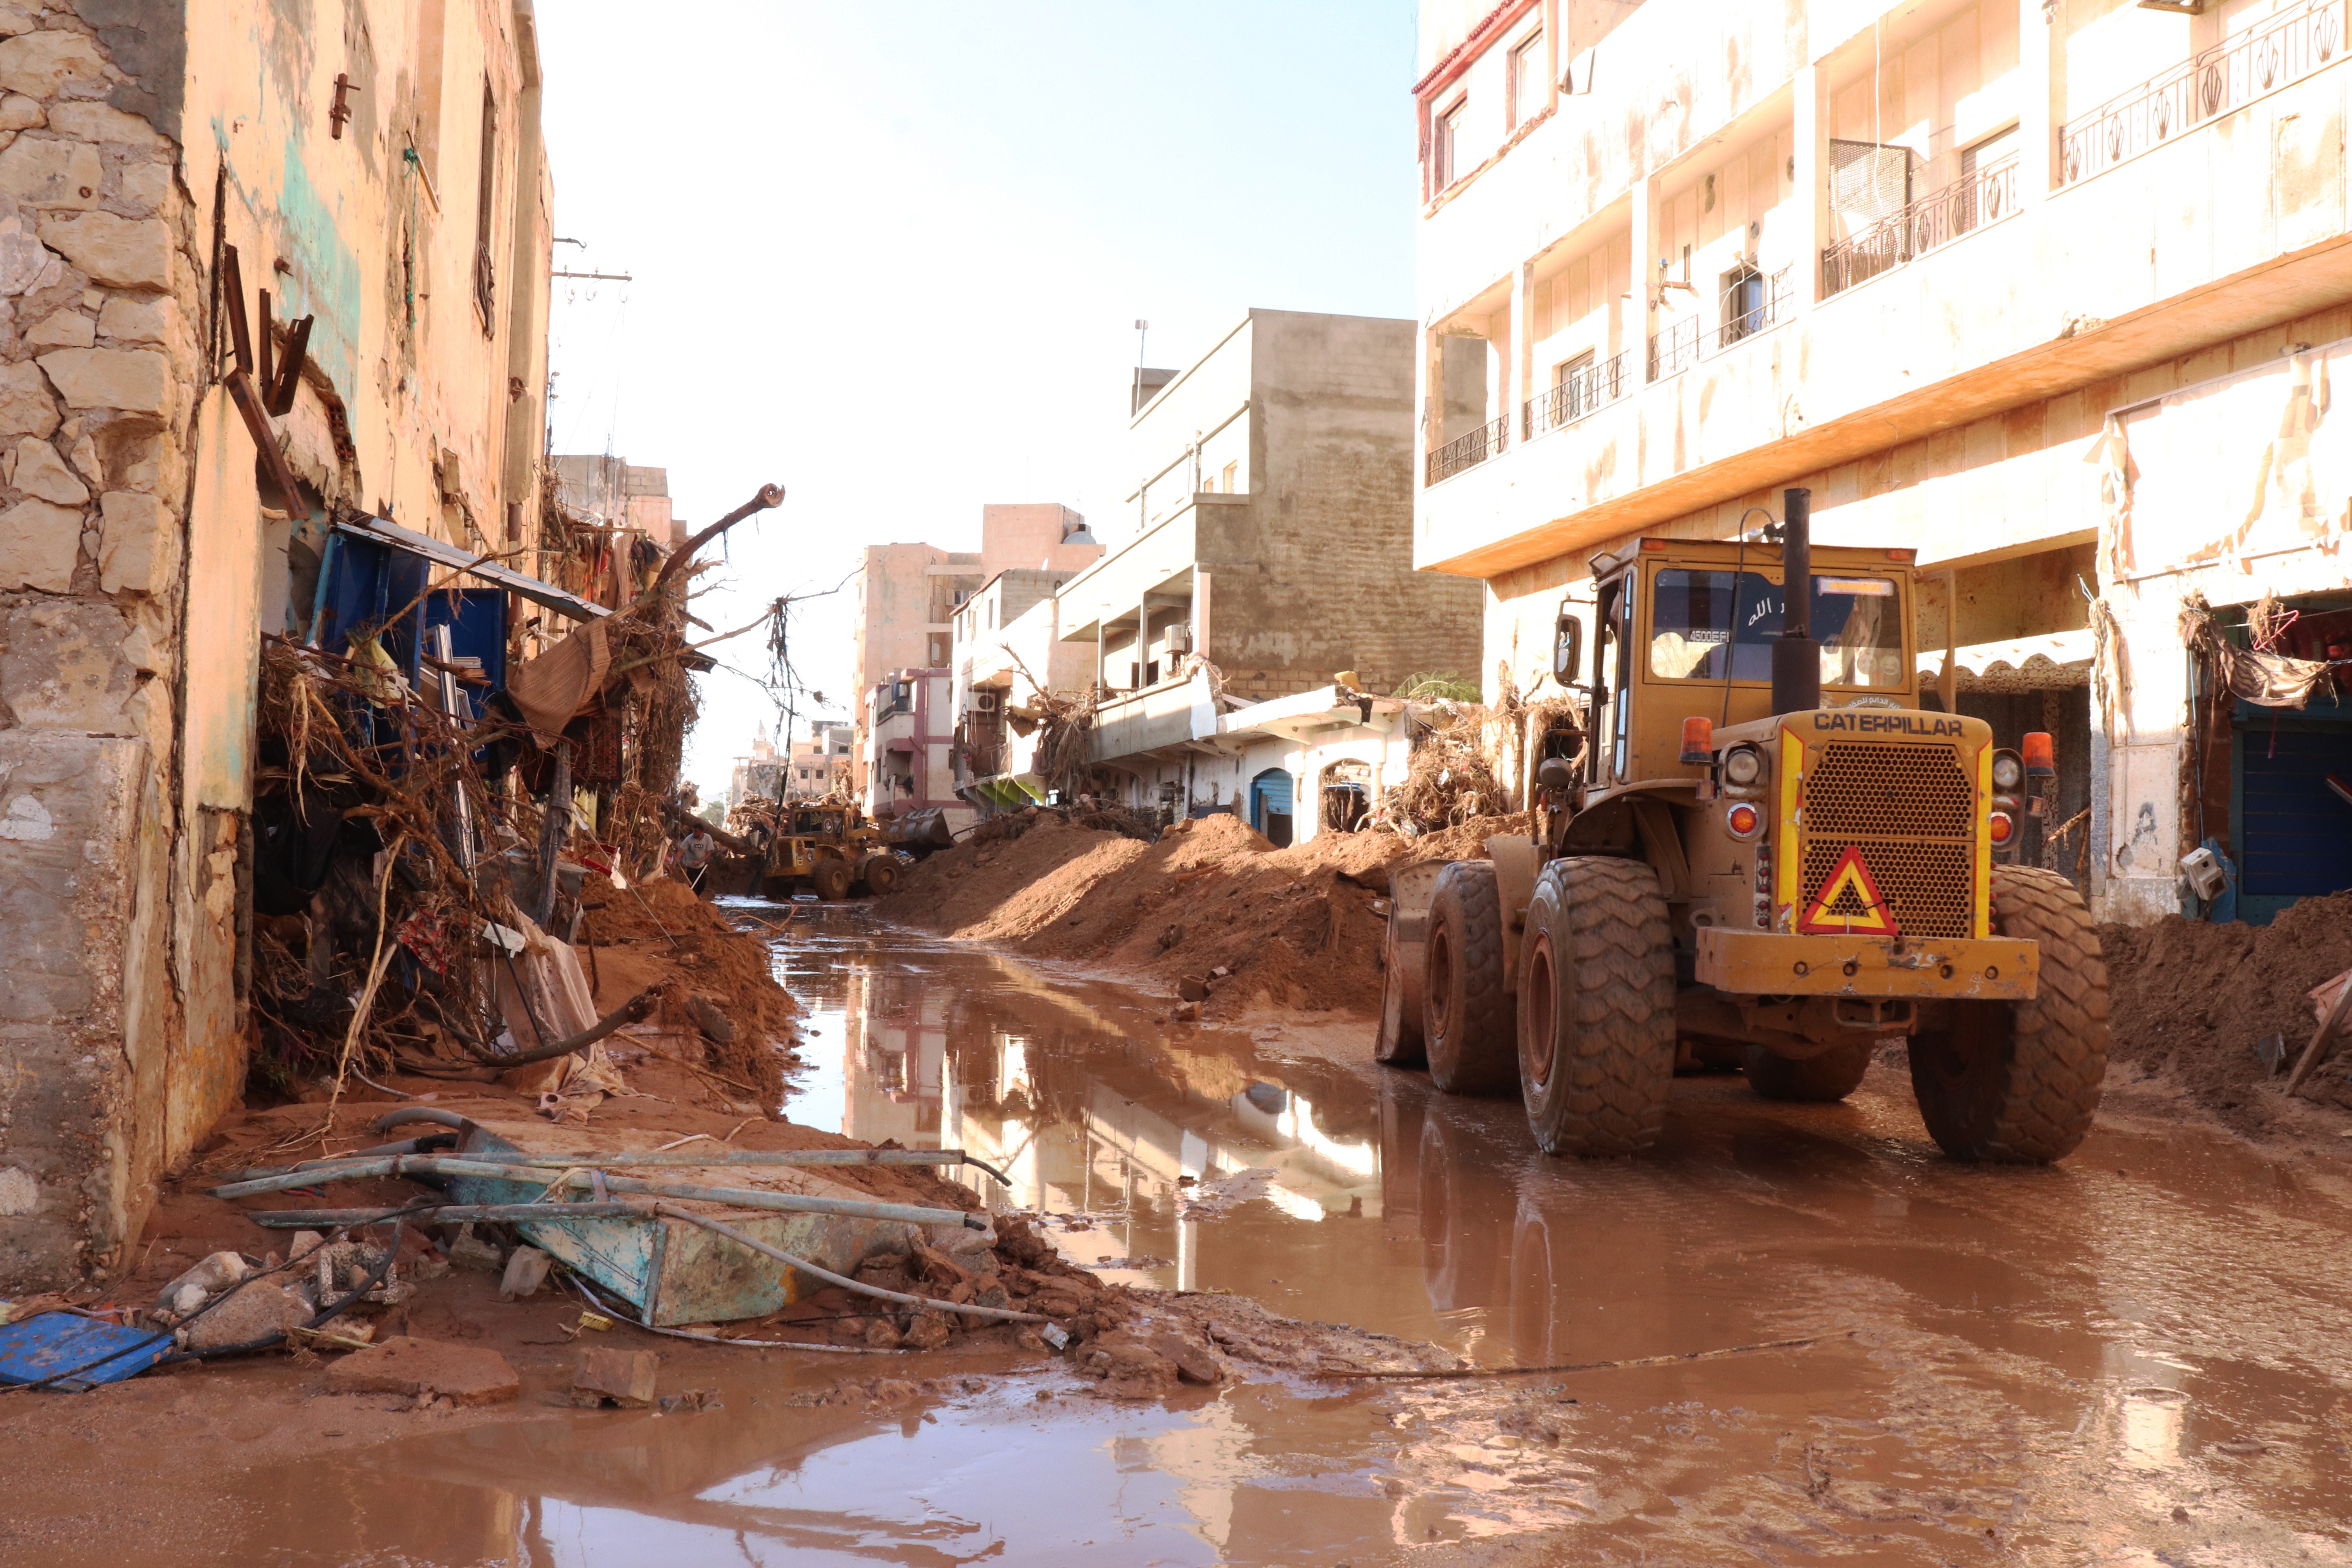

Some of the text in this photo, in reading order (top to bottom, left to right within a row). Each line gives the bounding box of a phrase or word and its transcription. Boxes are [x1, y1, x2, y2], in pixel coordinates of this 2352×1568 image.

[1748, 597, 1772, 626] الله
[1690, 630, 1730, 642] 4500EFI
[1814, 713, 1963, 737] CATERPILLAR
